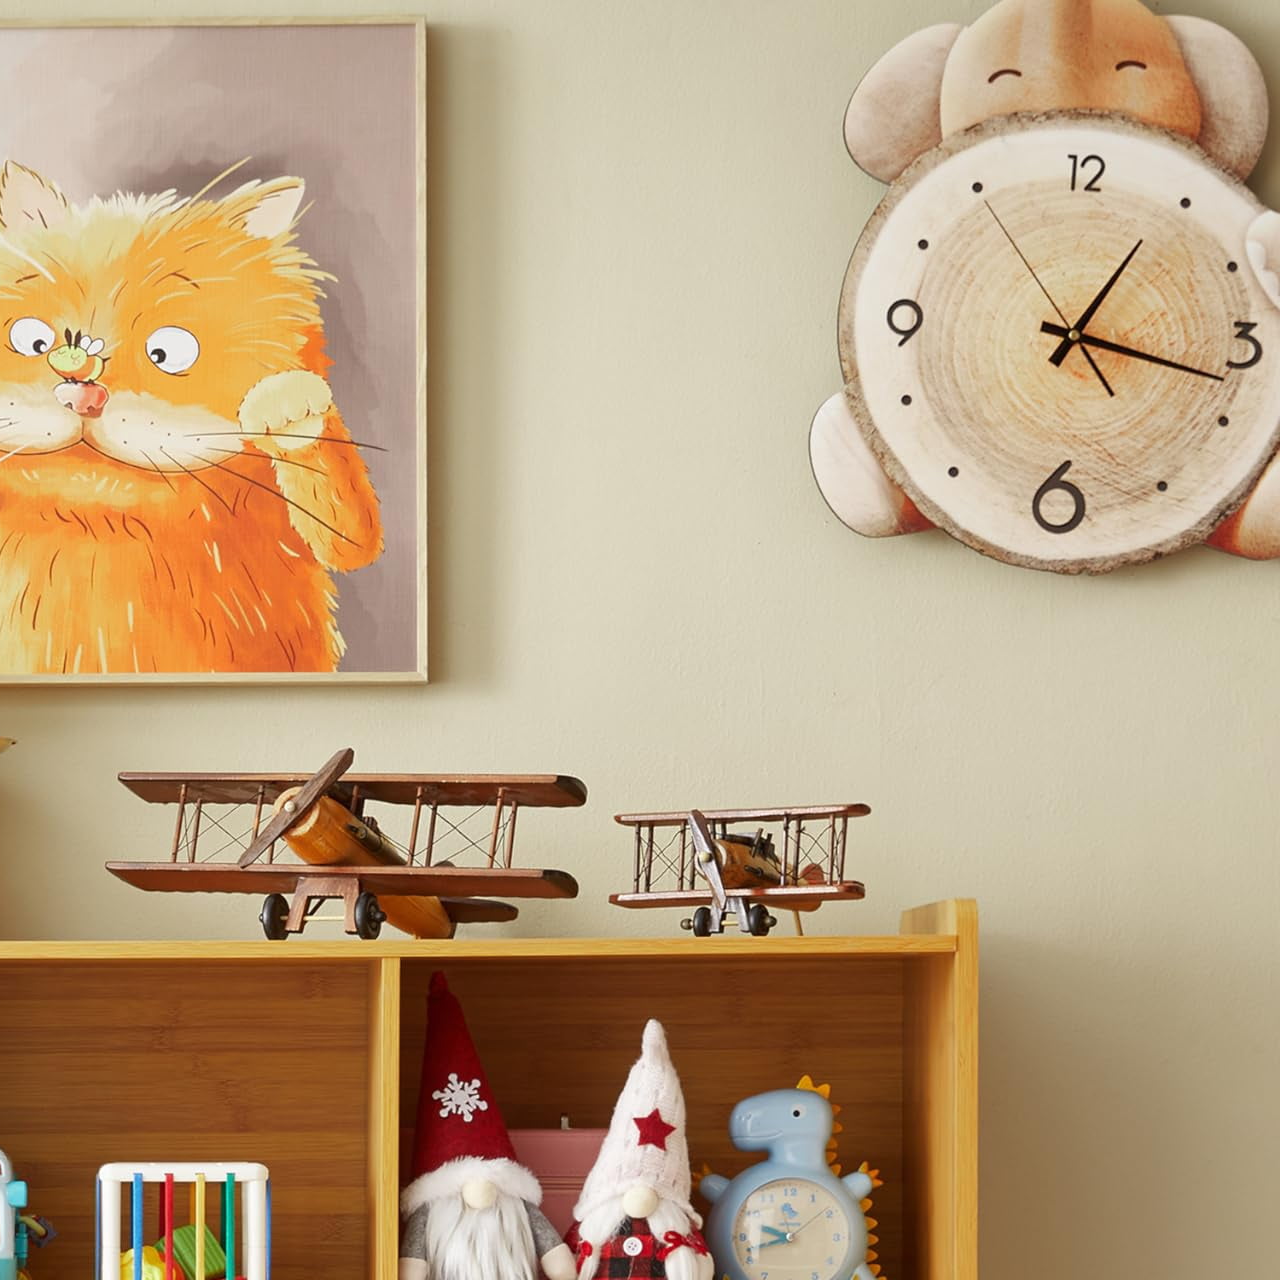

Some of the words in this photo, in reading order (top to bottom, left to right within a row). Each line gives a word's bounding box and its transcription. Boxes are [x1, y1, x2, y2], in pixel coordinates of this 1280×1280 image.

[1067, 154, 1106, 193] 12
[887, 298, 924, 348] 9
[1226, 321, 1263, 370] 3
[1032, 460, 1086, 534] 6
[783, 1187, 798, 1197] 12
